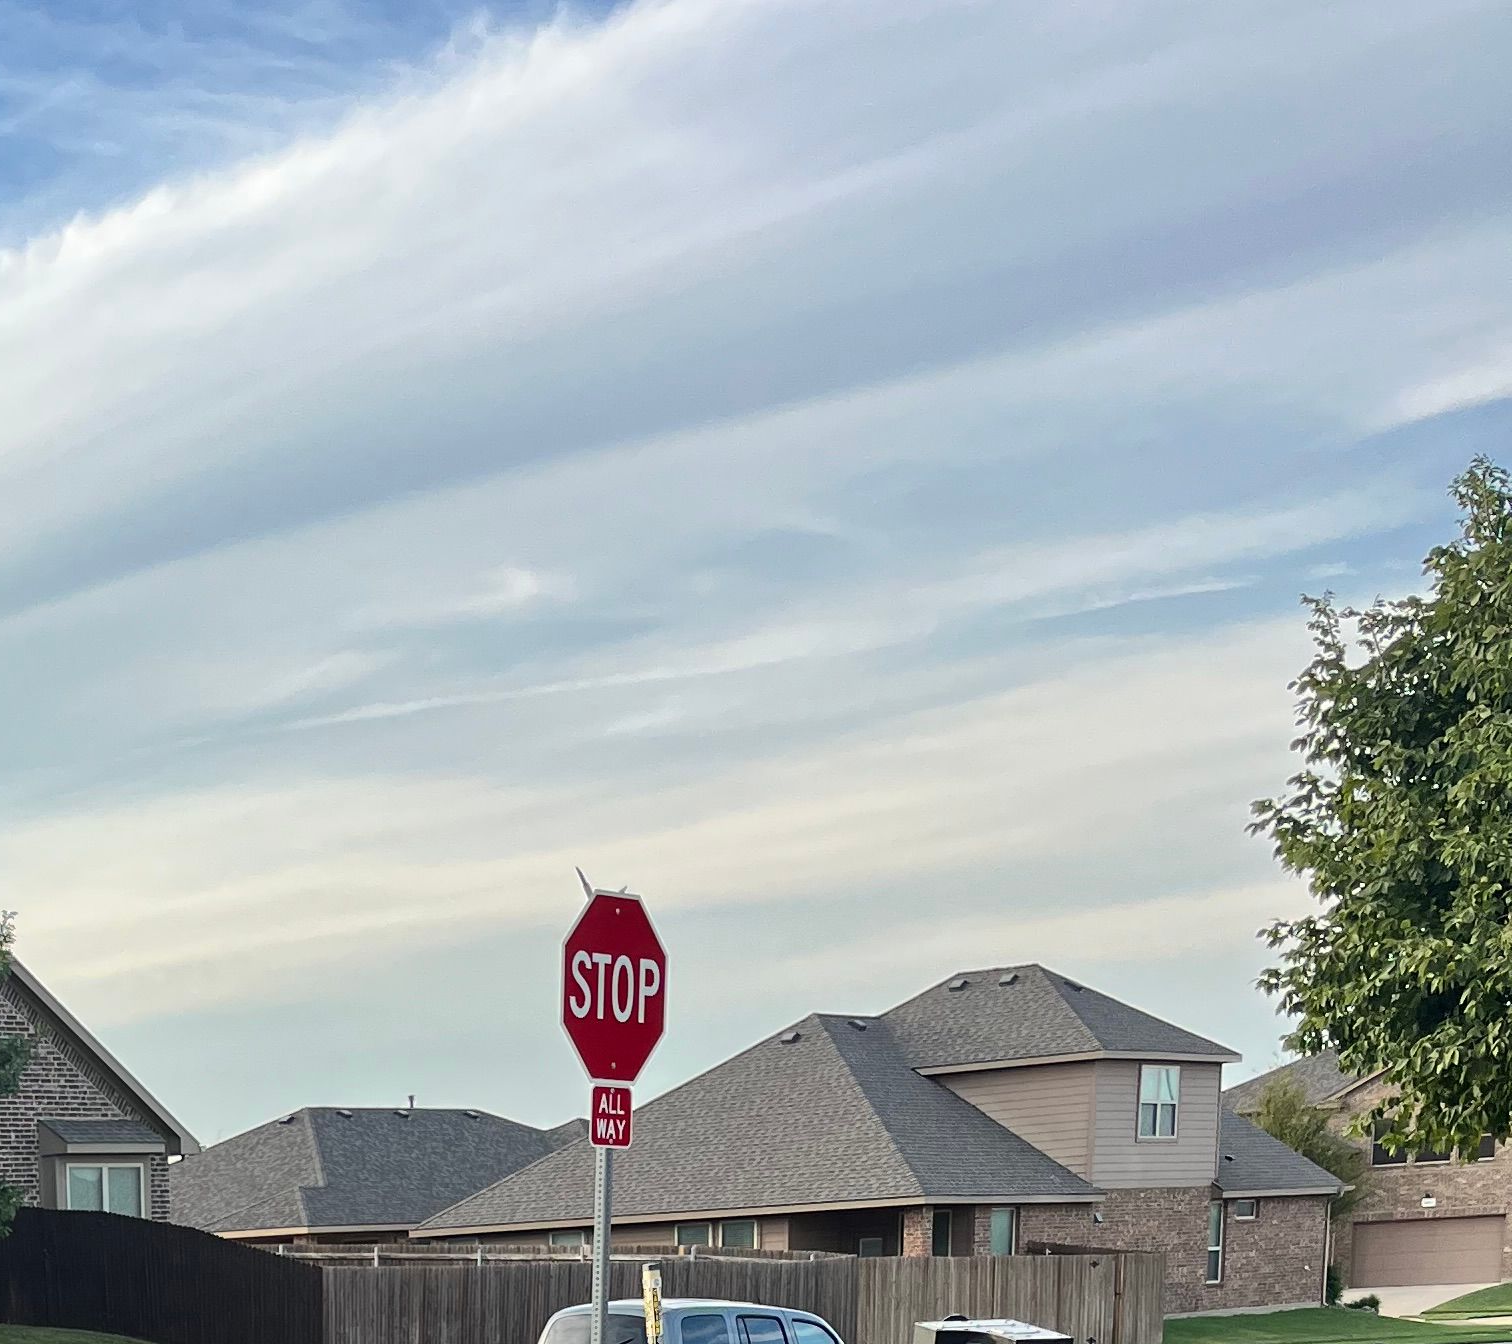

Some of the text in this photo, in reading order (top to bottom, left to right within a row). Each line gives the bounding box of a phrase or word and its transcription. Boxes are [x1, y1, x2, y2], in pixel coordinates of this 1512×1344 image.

[569, 950, 660, 1024] STOP
[598, 1093, 625, 1115] ALL
[596, 1118, 626, 1140] WAY
